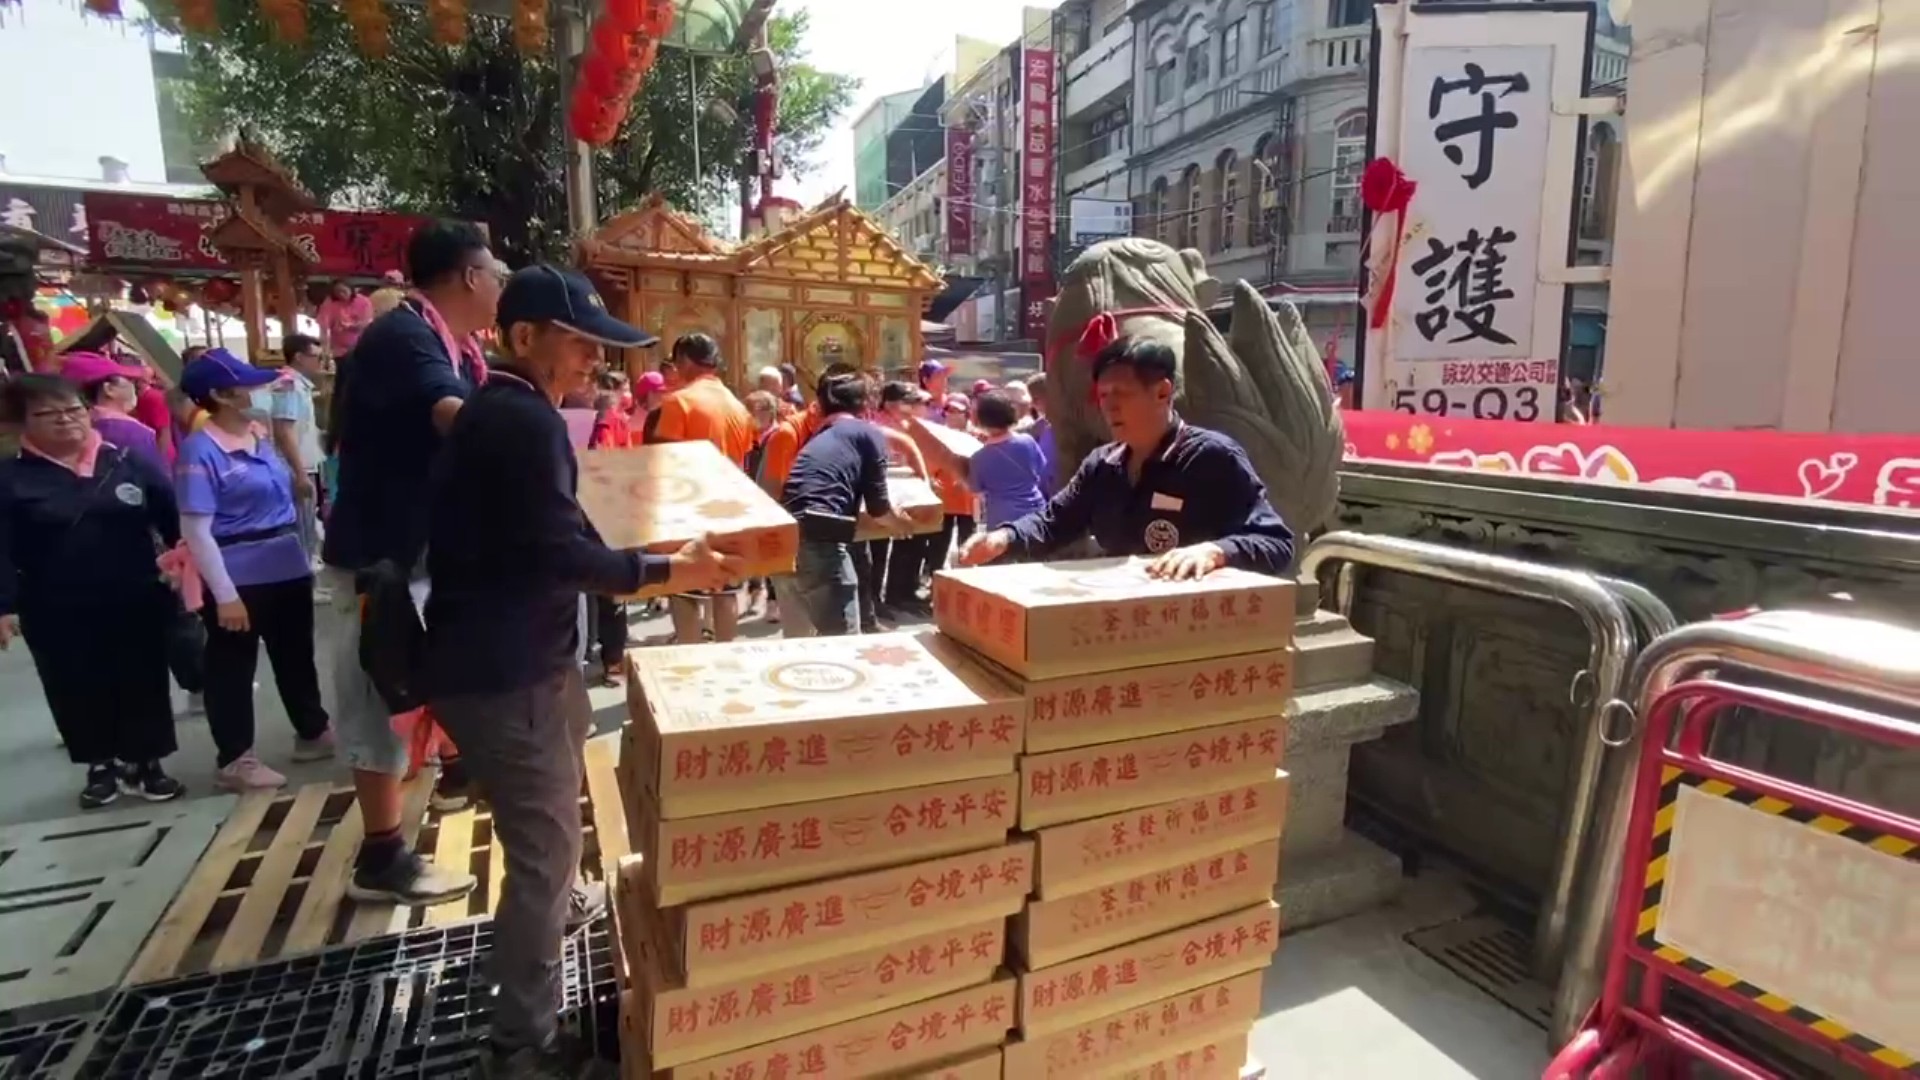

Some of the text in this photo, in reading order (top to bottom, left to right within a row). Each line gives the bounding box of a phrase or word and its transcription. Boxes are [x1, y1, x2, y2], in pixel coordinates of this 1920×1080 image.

[1410, 62, 1530, 345] 守護
[1031, 662, 1286, 722] 財源廣進 合境平安
[673, 714, 1016, 781] 財源廣進 合境平安
[1030, 729, 1278, 798] 財源廣進 合境平安
[670, 789, 1007, 870] 財源廣進 合境平安
[700, 857, 1024, 951] 財源廣進 合境平安
[666, 931, 995, 1036] 財源廣進 合境平安
[1032, 920, 1272, 1008] 財源廣進 合境平安
[705, 996, 1006, 1080] 源廣進 合境平安
